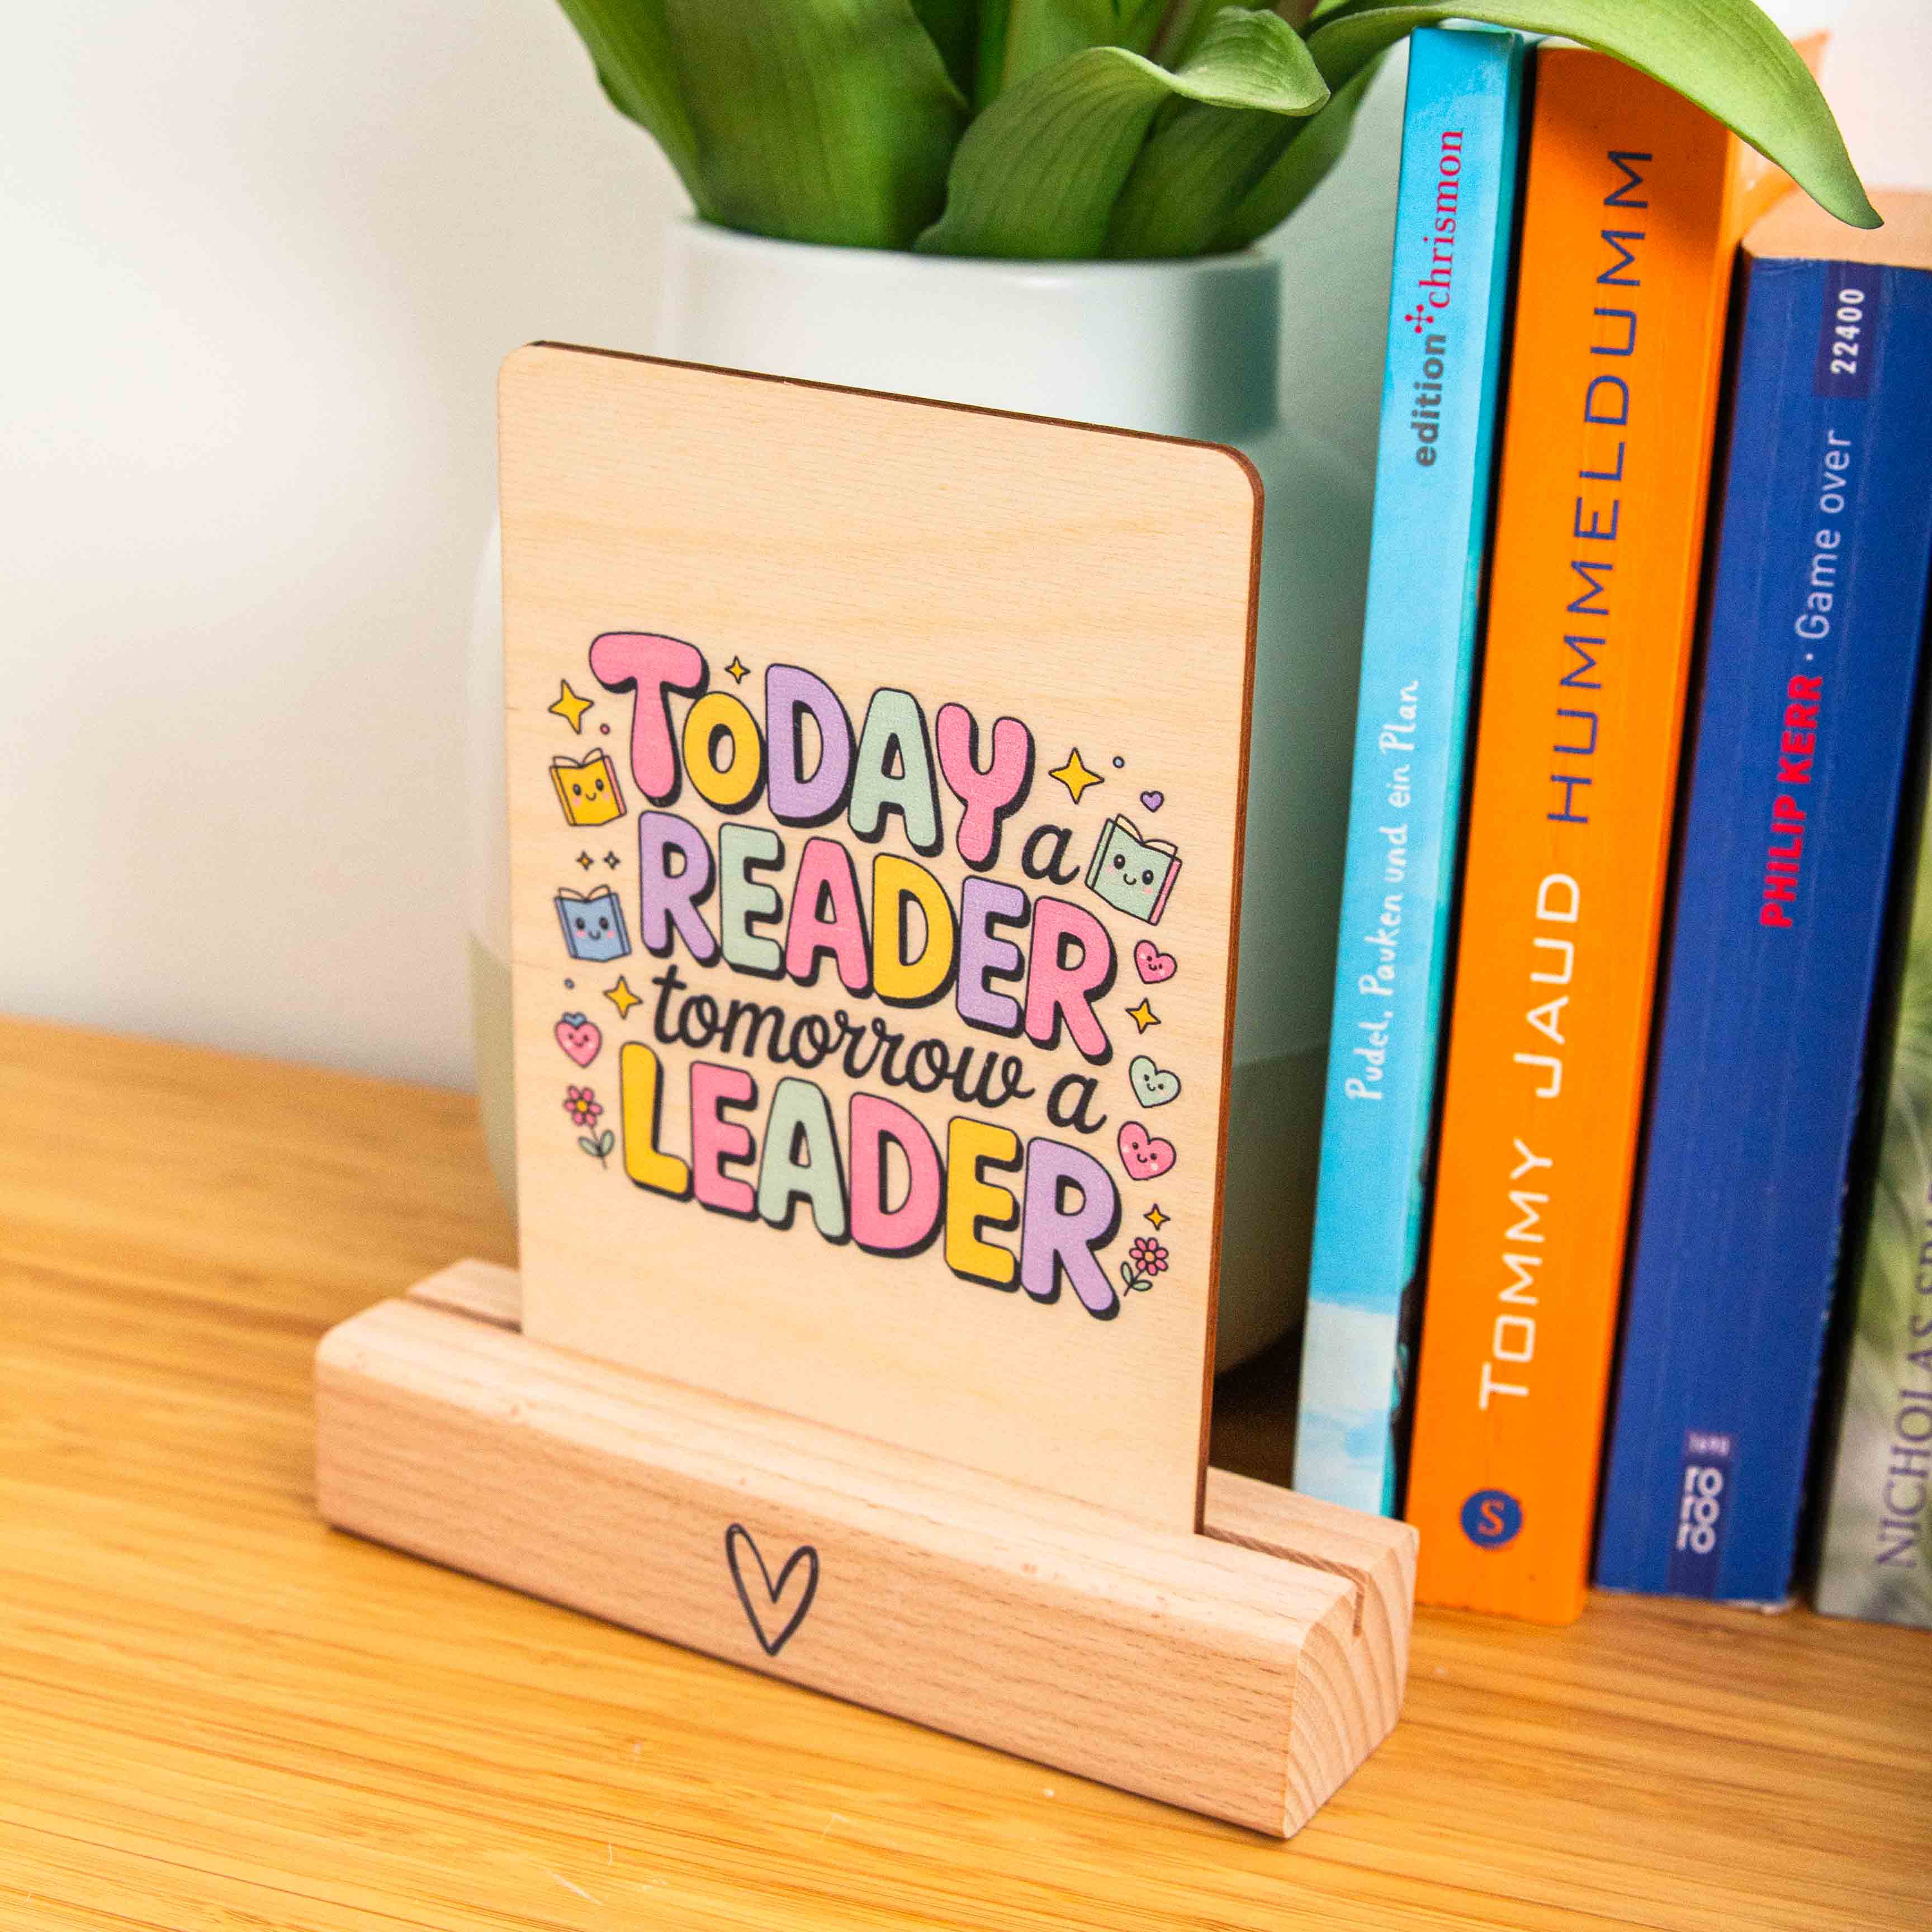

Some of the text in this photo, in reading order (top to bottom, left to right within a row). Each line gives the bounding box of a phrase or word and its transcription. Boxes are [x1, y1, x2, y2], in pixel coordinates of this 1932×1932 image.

[1412, 130, 1464, 467] edition chrismon
[1830, 288, 1865, 375] 22400
[589, 631, 1082, 886] TODAY a
[1377, 679, 1420, 755] Plan
[1759, 429, 1852, 928] PHILIP KERR Game over
[1379, 822, 1408, 884] und
[1385, 763, 1412, 808] ein
[1479, 148, 1655, 1410] TOMMY JAUD HUMMELDUMM
[638, 810, 1116, 1063] READER
[1358, 894, 1405, 997] Pauken
[650, 964, 1108, 1134] tomorrow a
[618, 1041, 1122, 1321] LEADER
[1479, 1499, 1504, 1537] S
